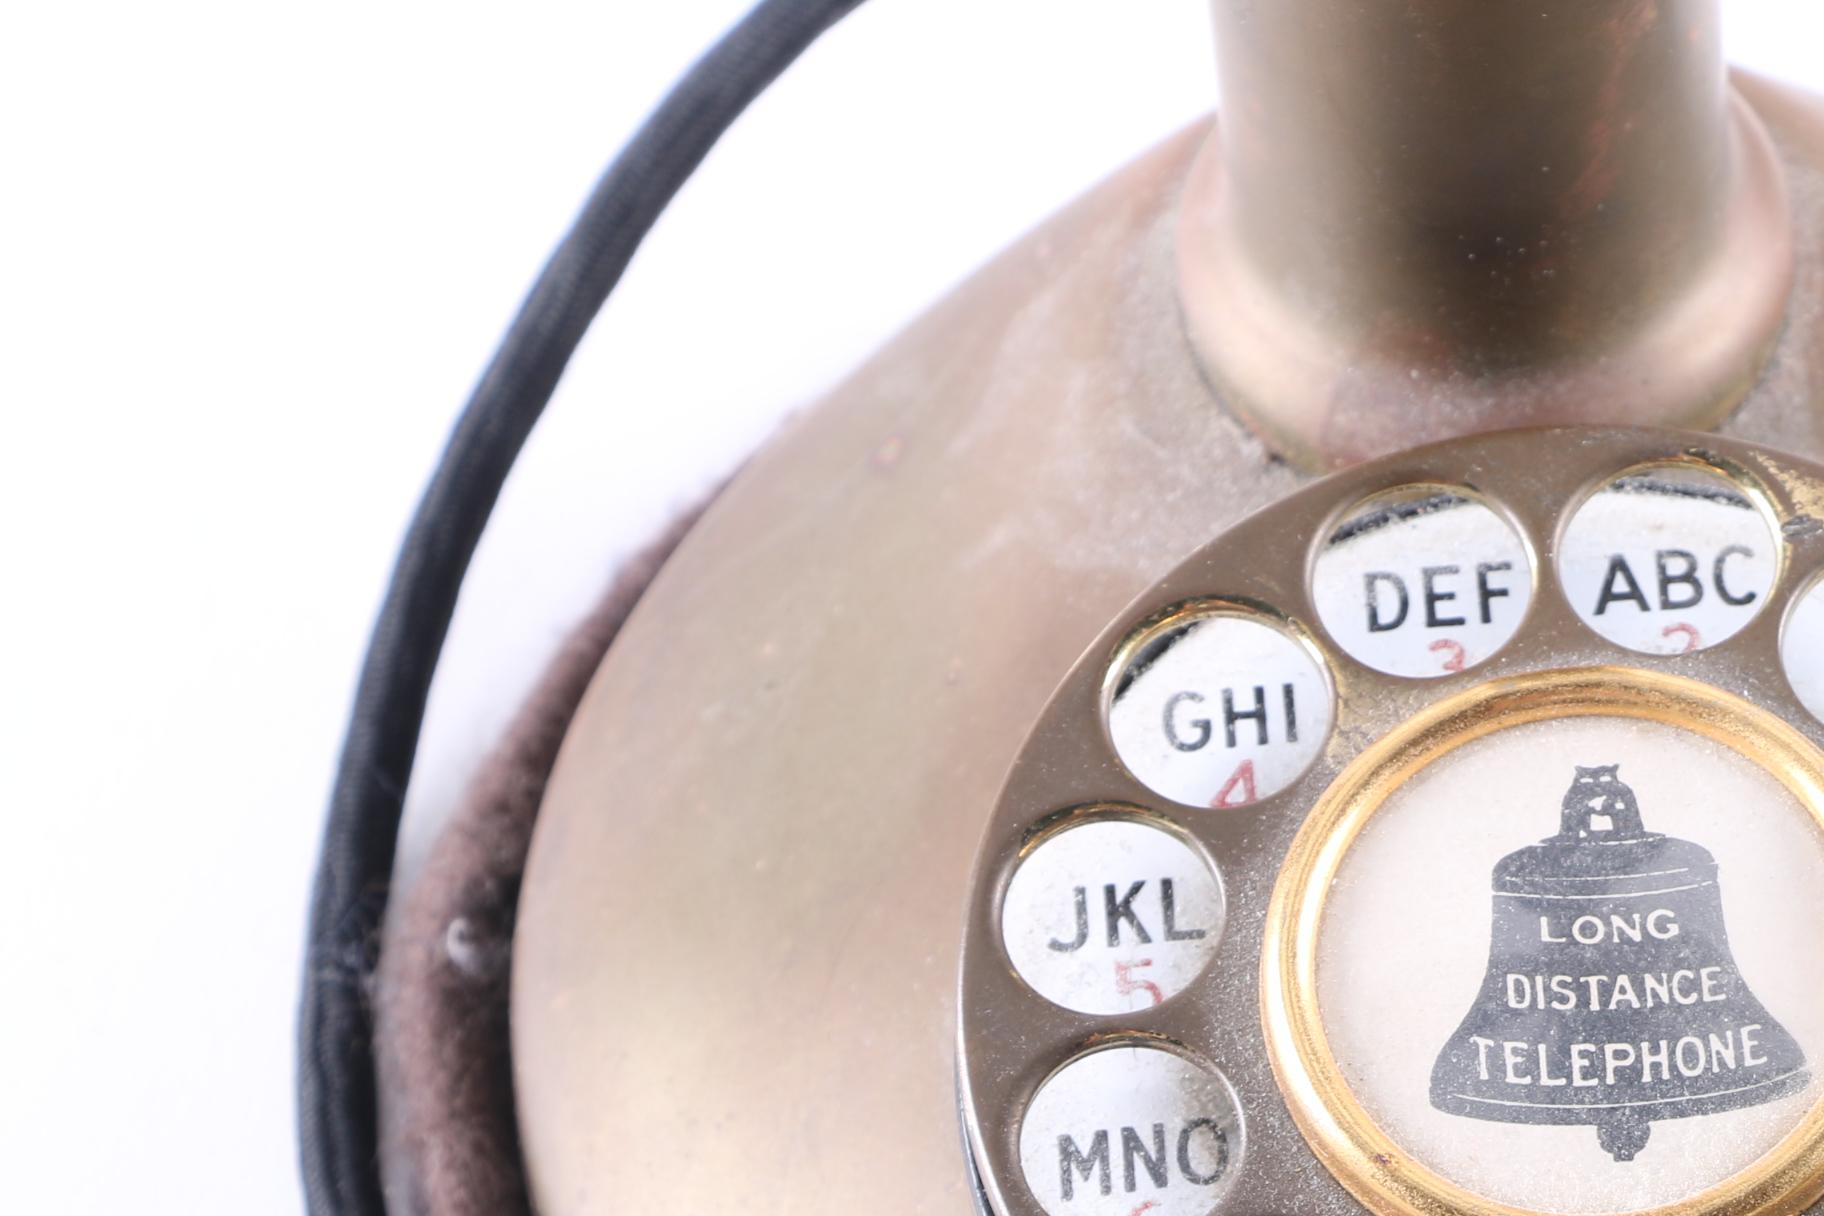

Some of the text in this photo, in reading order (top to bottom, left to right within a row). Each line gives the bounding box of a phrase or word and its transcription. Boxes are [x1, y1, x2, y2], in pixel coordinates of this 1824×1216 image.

[1364, 561, 1513, 633] DEF
[1591, 545, 1758, 616] ABC
[1162, 682, 1298, 752] GHI
[1209, 758, 1259, 808] 4
[1046, 876, 1207, 953] JKL
[1539, 908, 1680, 944] LONG
[1114, 958, 1164, 1006] 5
[1506, 966, 1727, 1011] DISTANCE
[1468, 1024, 1768, 1087] TELEPHONE
[1057, 1117, 1229, 1201] MNO
